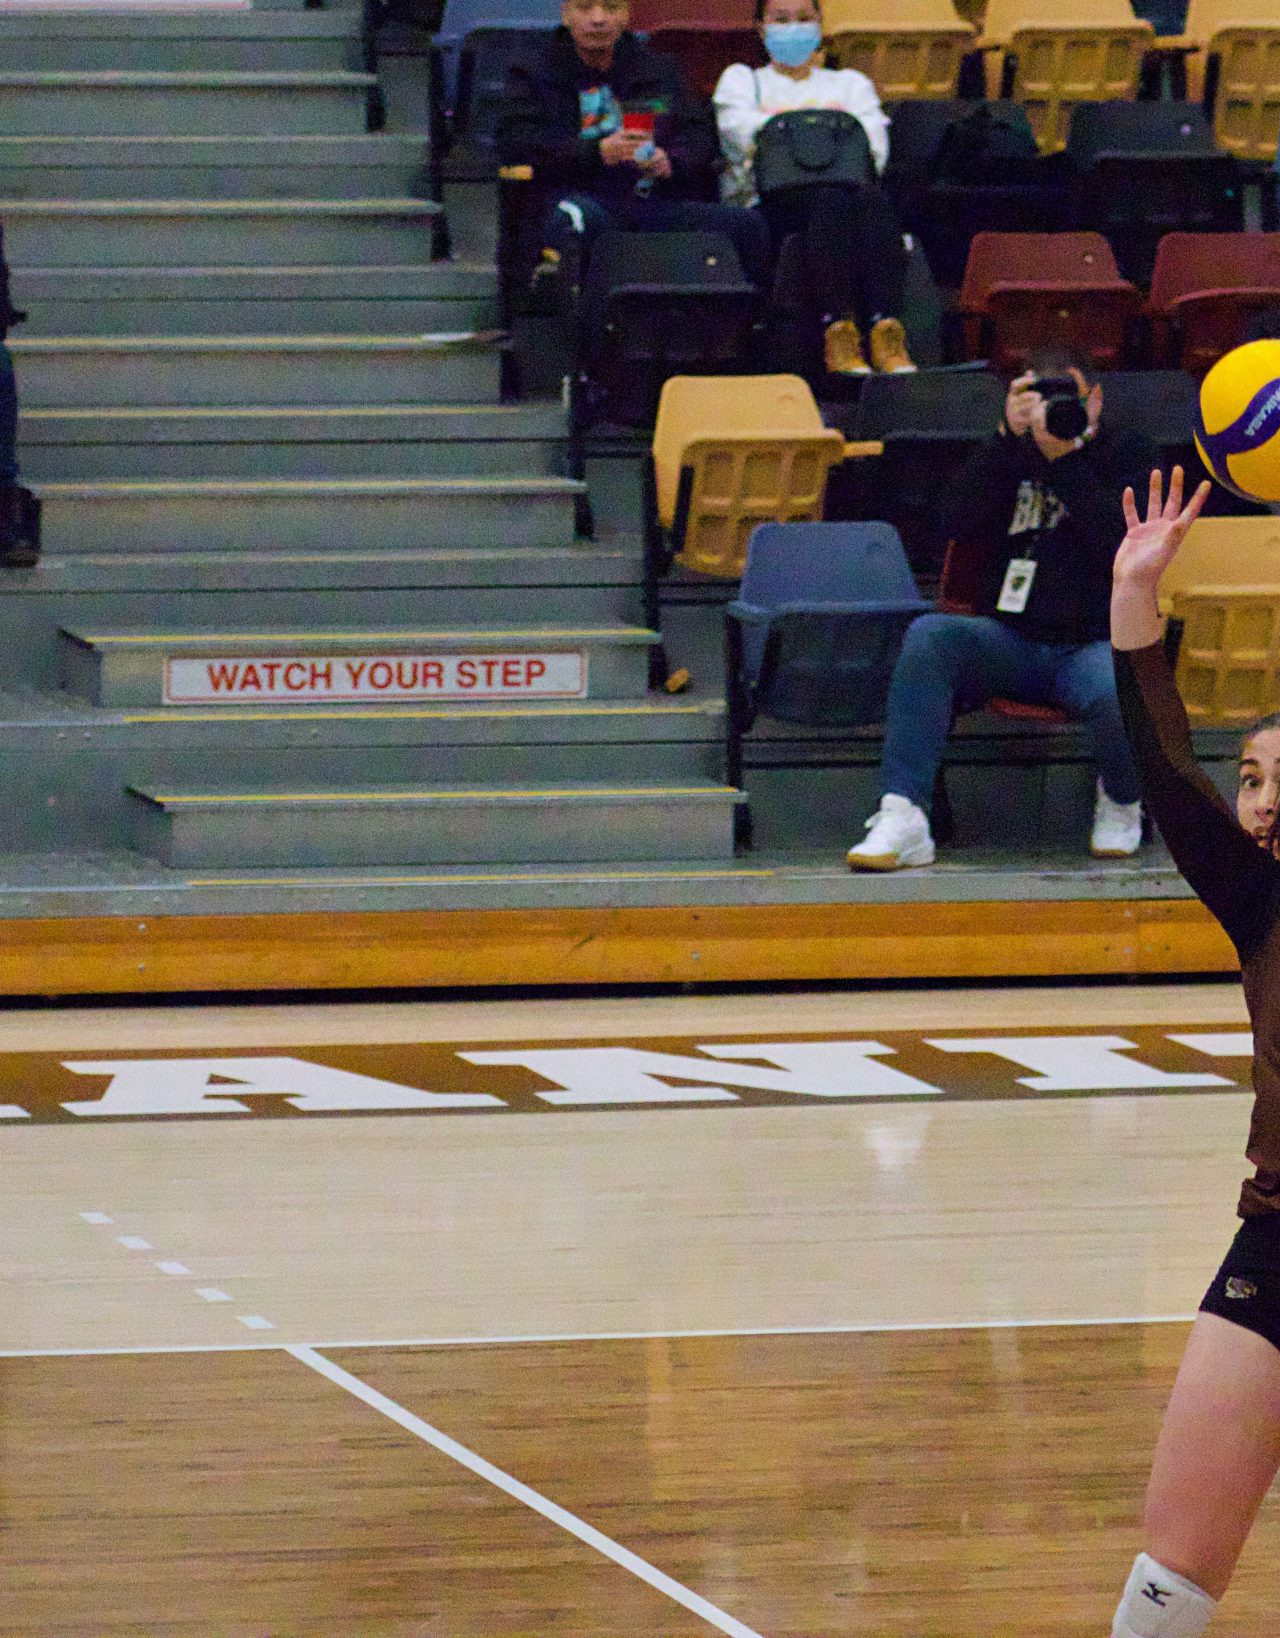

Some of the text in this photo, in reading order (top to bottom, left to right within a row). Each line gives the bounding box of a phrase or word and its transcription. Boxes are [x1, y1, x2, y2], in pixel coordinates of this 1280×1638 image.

[207, 659, 546, 691] WATCH YOUR STEP
